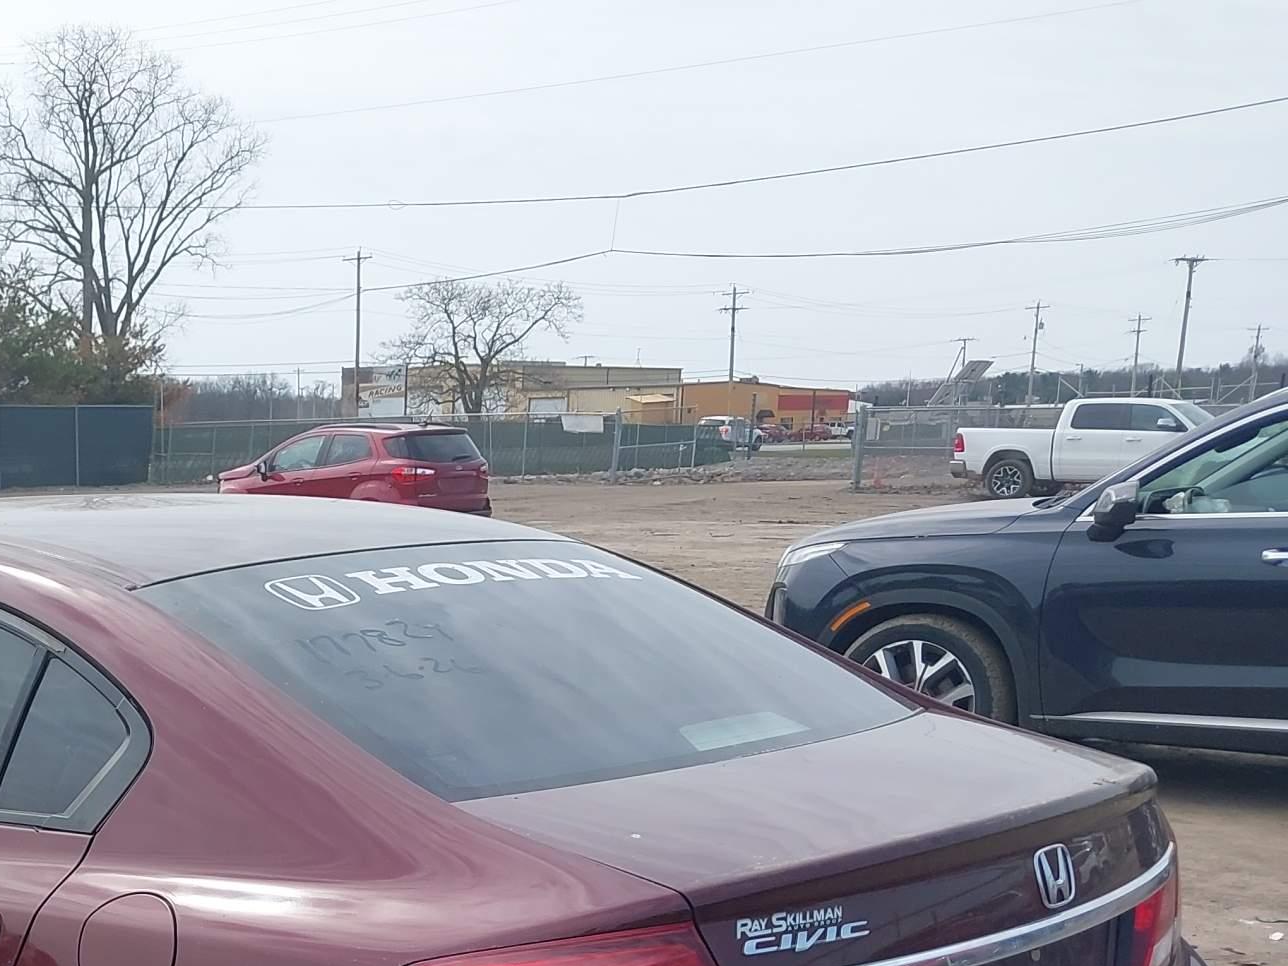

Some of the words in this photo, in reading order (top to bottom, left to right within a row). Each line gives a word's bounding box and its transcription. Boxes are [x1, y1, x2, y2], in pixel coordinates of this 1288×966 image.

[345, 559, 642, 595] HONDA
[736, 917, 772, 940] RAY
[771, 905, 843, 933] SKILLMAN
[743, 921, 870, 955] CIVIC
